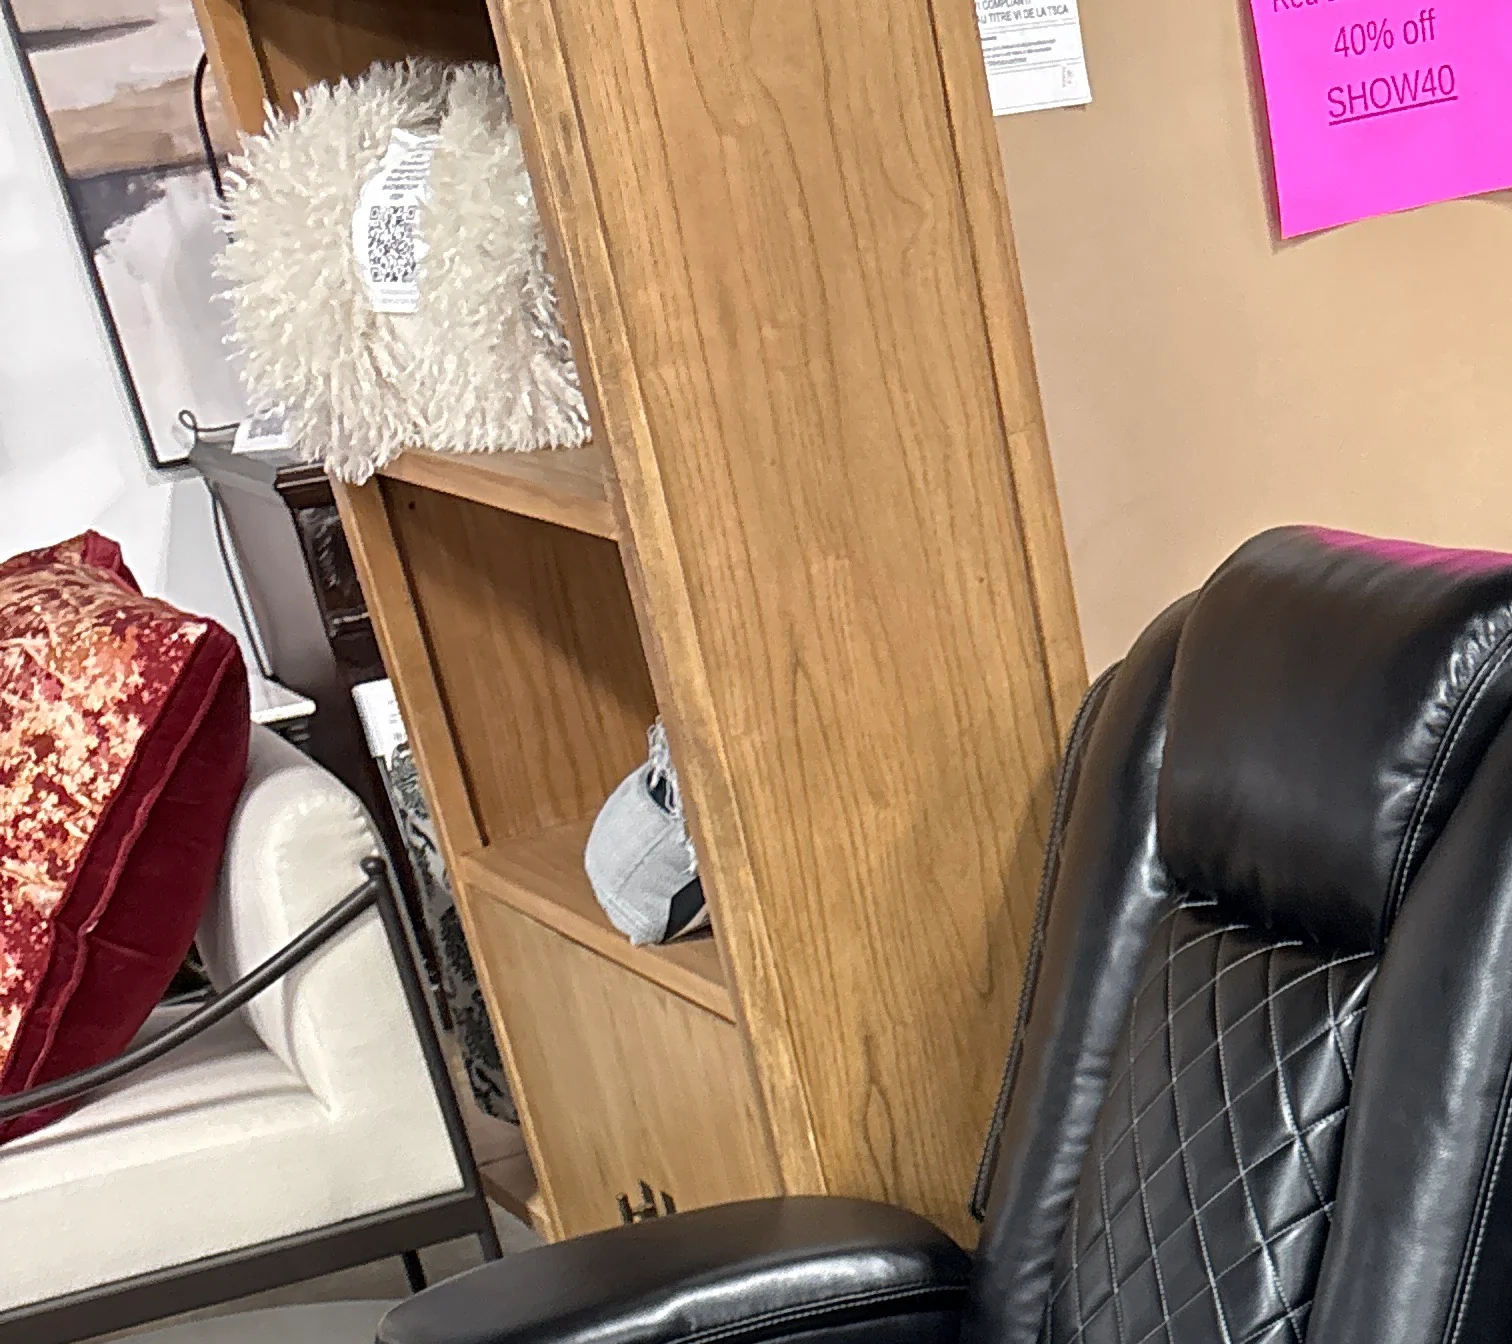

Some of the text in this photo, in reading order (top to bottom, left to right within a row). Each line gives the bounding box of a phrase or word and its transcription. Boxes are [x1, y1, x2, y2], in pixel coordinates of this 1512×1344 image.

[1023, 7, 1035, 19] DE
[1036, 7, 1047, 17] LA
[1334, 8, 1435, 57] 40% off
[1327, 64, 1456, 119] SHOW40
